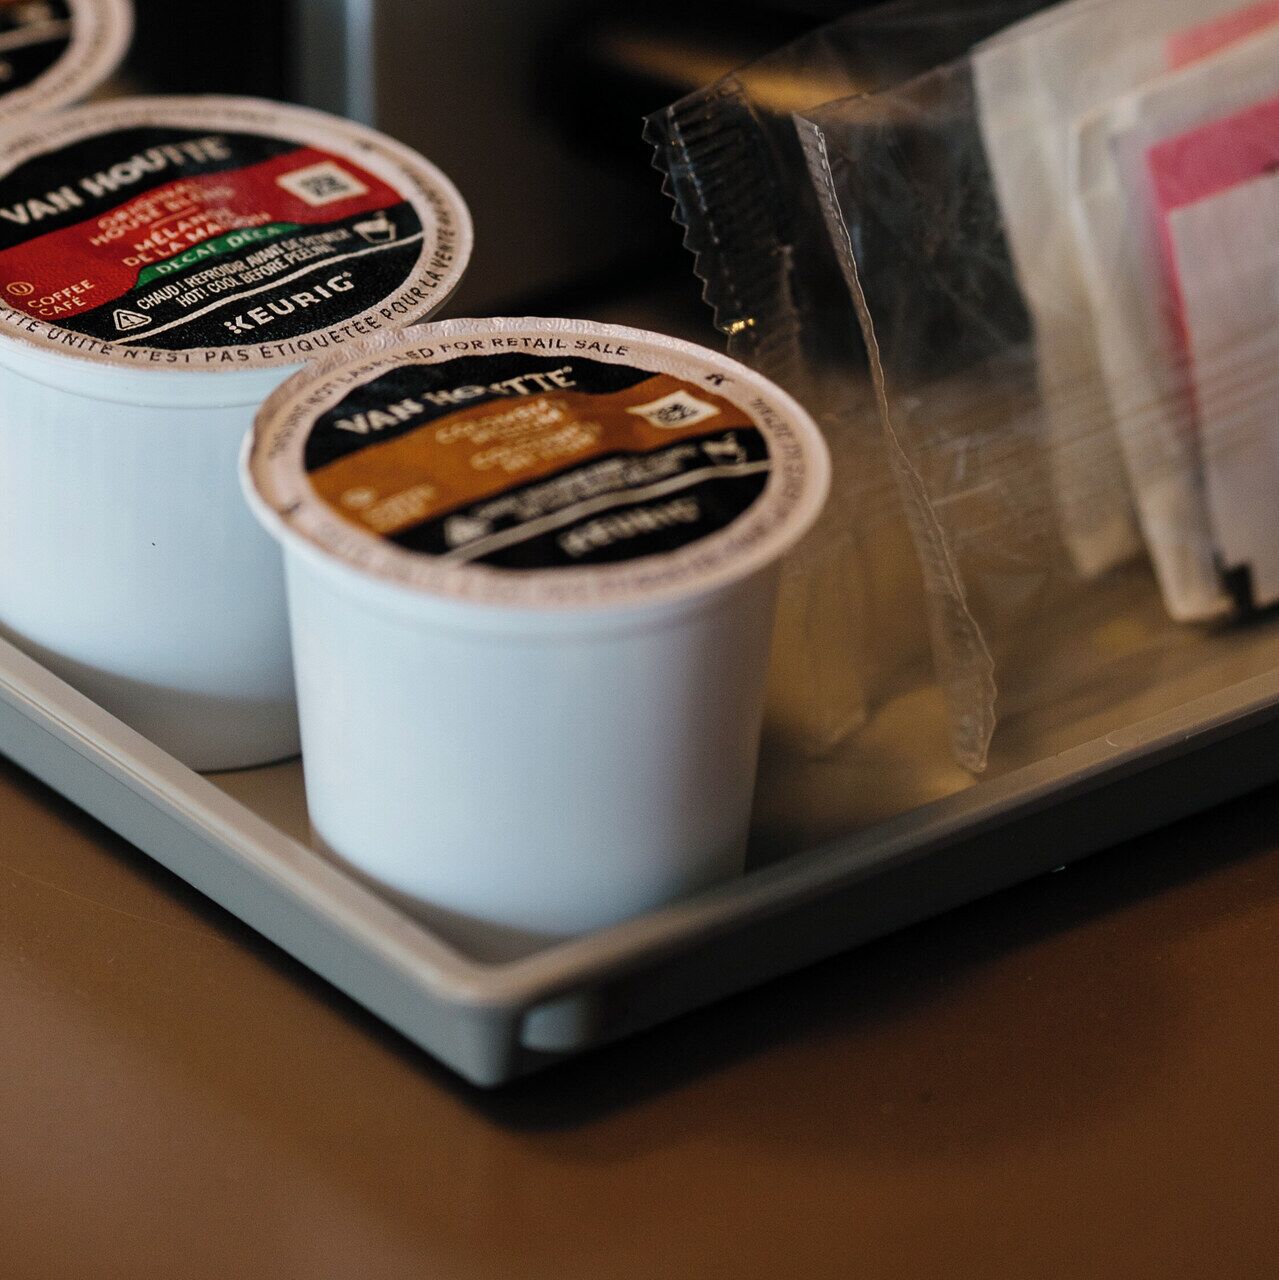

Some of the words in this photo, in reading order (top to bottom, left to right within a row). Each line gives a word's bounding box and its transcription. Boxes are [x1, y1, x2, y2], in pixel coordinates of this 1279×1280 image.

[79, 136, 233, 198] HOUTTE
[122, 252, 154, 267] DE
[155, 243, 217, 274] DECAF
[186, 260, 249, 289] REFROIDIR
[245, 243, 287, 264] AVANT
[27, 280, 95, 309] COFFEE
[175, 289, 209, 309] HOT!
[206, 278, 244, 295] COOL
[243, 259, 290, 284] BEFORE
[38, 297, 87, 316] CAFÉ
[205, 351, 251, 363] PAS
[379, 287, 429, 321] POUR
[419, 271, 444, 289] LA
[223, 271, 356, 335] KEURIG
[440, 337, 492, 354] FOR
[491, 337, 568, 351] RETAIL
[574, 340, 630, 357] SALE
[334, 398, 424, 435] VAN
